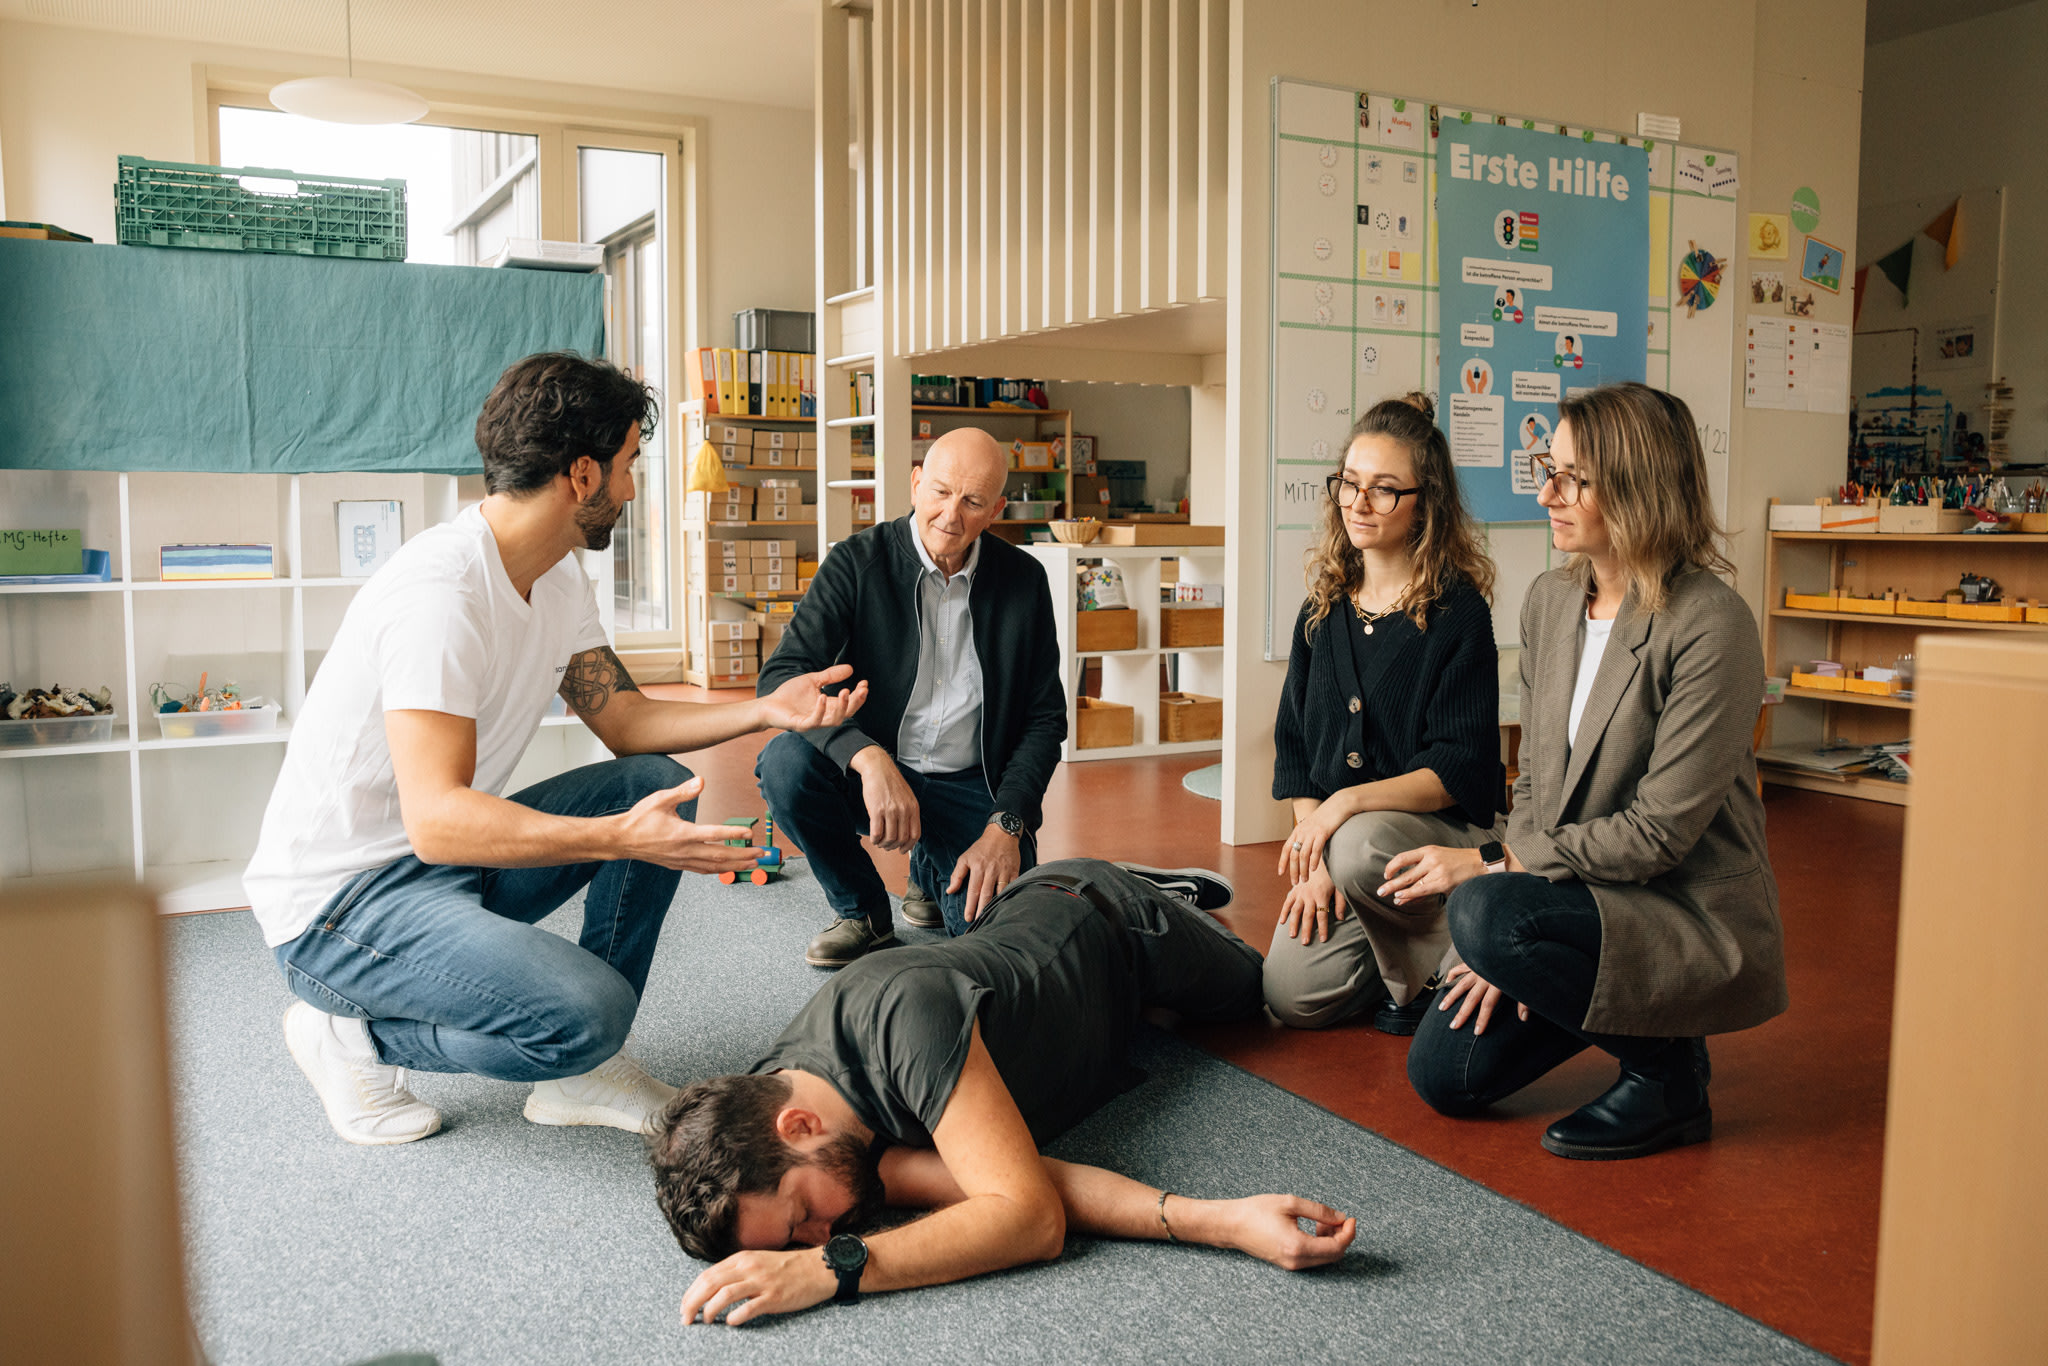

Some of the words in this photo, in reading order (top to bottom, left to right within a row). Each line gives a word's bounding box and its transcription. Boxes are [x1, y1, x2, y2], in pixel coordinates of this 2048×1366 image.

[1450, 142, 1539, 190] Erste
[1548, 157, 1629, 201] Hilfe
[0, 530, 69, 551] MG-Hefte
